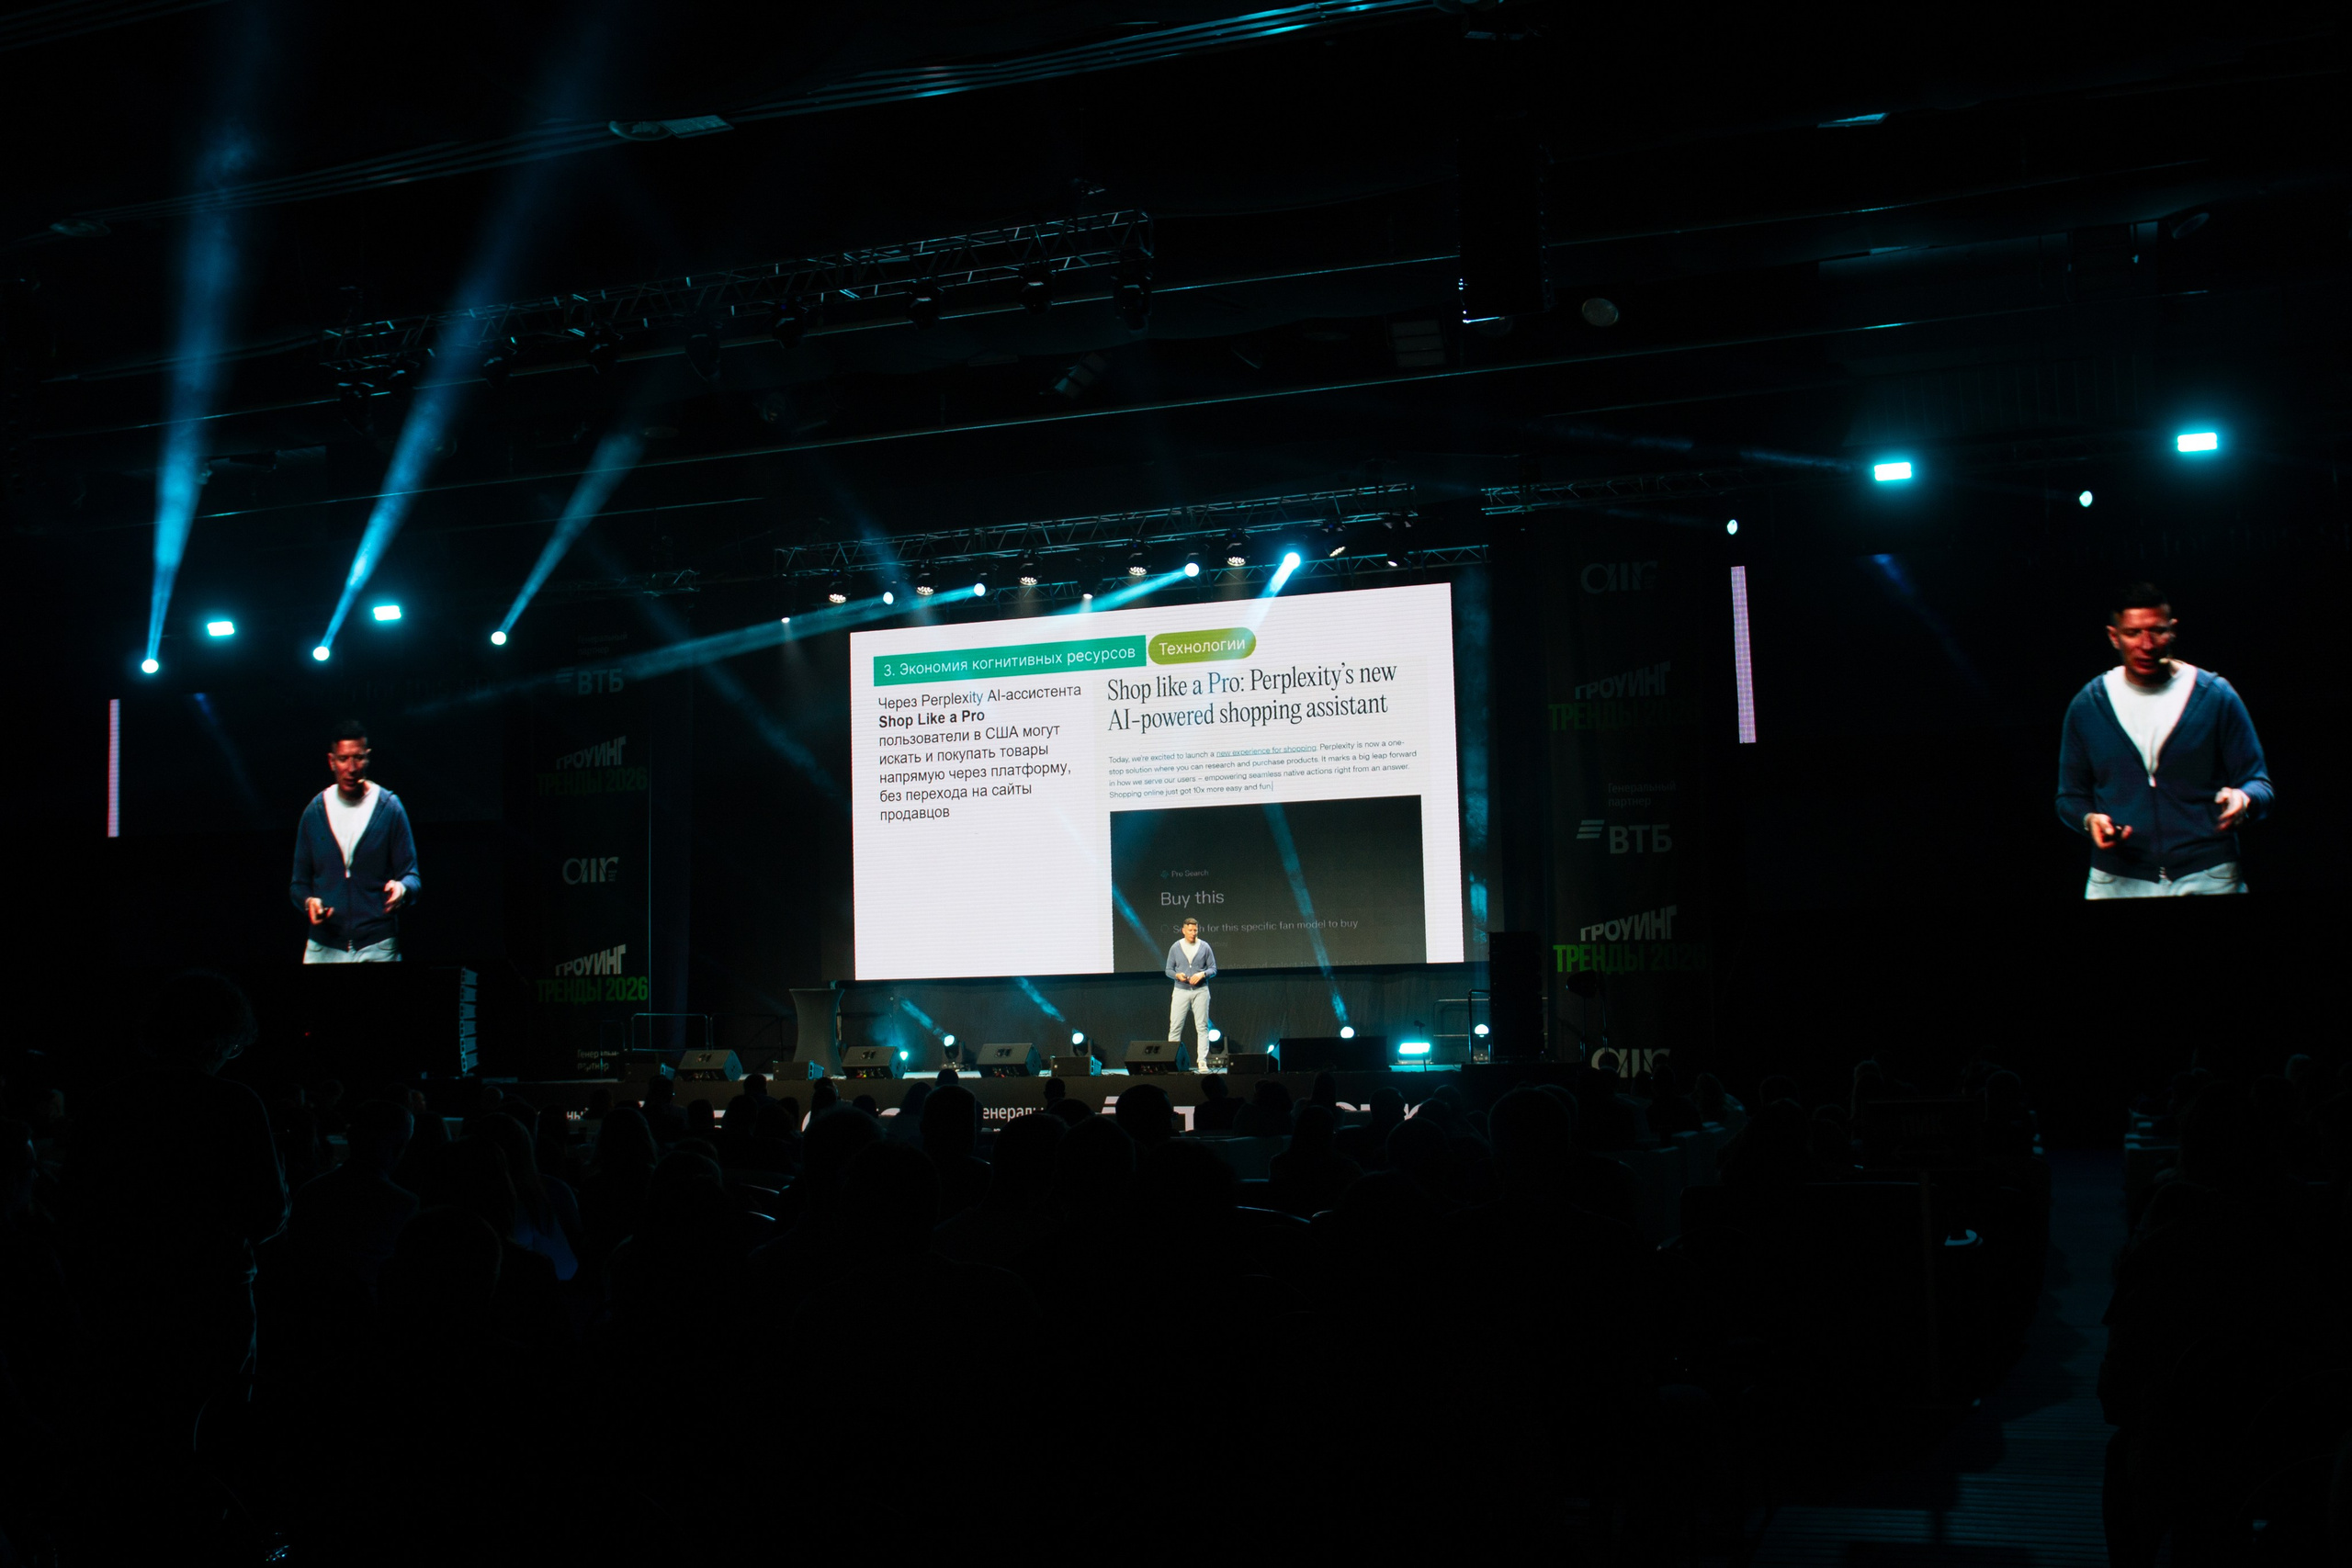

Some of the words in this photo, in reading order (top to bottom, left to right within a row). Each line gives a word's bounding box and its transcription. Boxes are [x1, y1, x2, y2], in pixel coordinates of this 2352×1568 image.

[1159, 637, 1246, 656] Технологии
[884, 664, 895, 677] 3.
[899, 661, 967, 675] Экономия
[972, 654, 1062, 670] когнитивных
[1068, 648, 1136, 666] ресурсов
[577, 668, 625, 695] ВТБ
[1108, 679, 1151, 704] Shop
[1157, 675, 1187, 697] like
[1193, 680, 1203, 695] a
[1208, 672, 1244, 694] Pro:
[1360, 666, 1396, 682] new
[1575, 660, 1671, 700] ГРОУИНГ
[878, 697, 917, 712] Через
[922, 691, 983, 708] Perplexity
[988, 686, 1081, 702] AI-ассистента
[879, 716, 913, 729] Shop
[918, 712, 945, 725] Like
[950, 714, 957, 723] a
[962, 710, 985, 722] Pro
[1108, 703, 1215, 734] AI-powered
[1220, 700, 1302, 727] shopping
[1306, 694, 1387, 717] assistant
[879, 731, 969, 747] пользователи
[974, 731, 981, 740] в
[986, 726, 1019, 739] США
[1023, 726, 1060, 739] могут
[556, 735, 627, 771] ГРОУИНГ
[879, 751, 922, 765] искать
[926, 752, 933, 762] и
[937, 749, 996, 763] покупать
[1000, 745, 1048, 759] товары
[1150, 753, 1175, 761] excited
[1232, 748, 1270, 757] experience
[1319, 742, 1355, 750] Perplexity
[880, 771, 944, 785] напрямую
[949, 768, 987, 782] через
[991, 762, 1070, 778] платформу,
[1252, 759, 1284, 767] purchase
[605, 766, 648, 792] 2026
[1204, 773, 1247, 782] empowering
[1249, 771, 1282, 779] seamless
[880, 790, 901, 802] без
[906, 788, 967, 803] перехода
[972, 787, 988, 797] на
[991, 783, 1032, 795] сайты
[1165, 788, 1178, 796] just
[1608, 796, 1652, 808] партнер
[880, 807, 950, 823] продавцов
[1609, 823, 1673, 854] ВТБ
[1184, 869, 1209, 877] Search
[1161, 892, 1191, 908] Buy
[1194, 890, 1224, 904] this
[1207, 923, 1219, 932] for
[1222, 922, 1239, 932] this
[1241, 921, 1277, 932] specific
[1279, 920, 1295, 930] fan
[1296, 919, 1326, 930] model
[1329, 920, 1338, 929] to
[1340, 919, 1359, 930] buy
[1580, 904, 1677, 942] ГРОУИНГ
[555, 943, 627, 976] ГРОУИНГ
[1552, 943, 1645, 975] ТРЕНДЫ
[536, 976, 603, 1004] ТРЕНДЫ
[605, 976, 649, 1001] 2026
